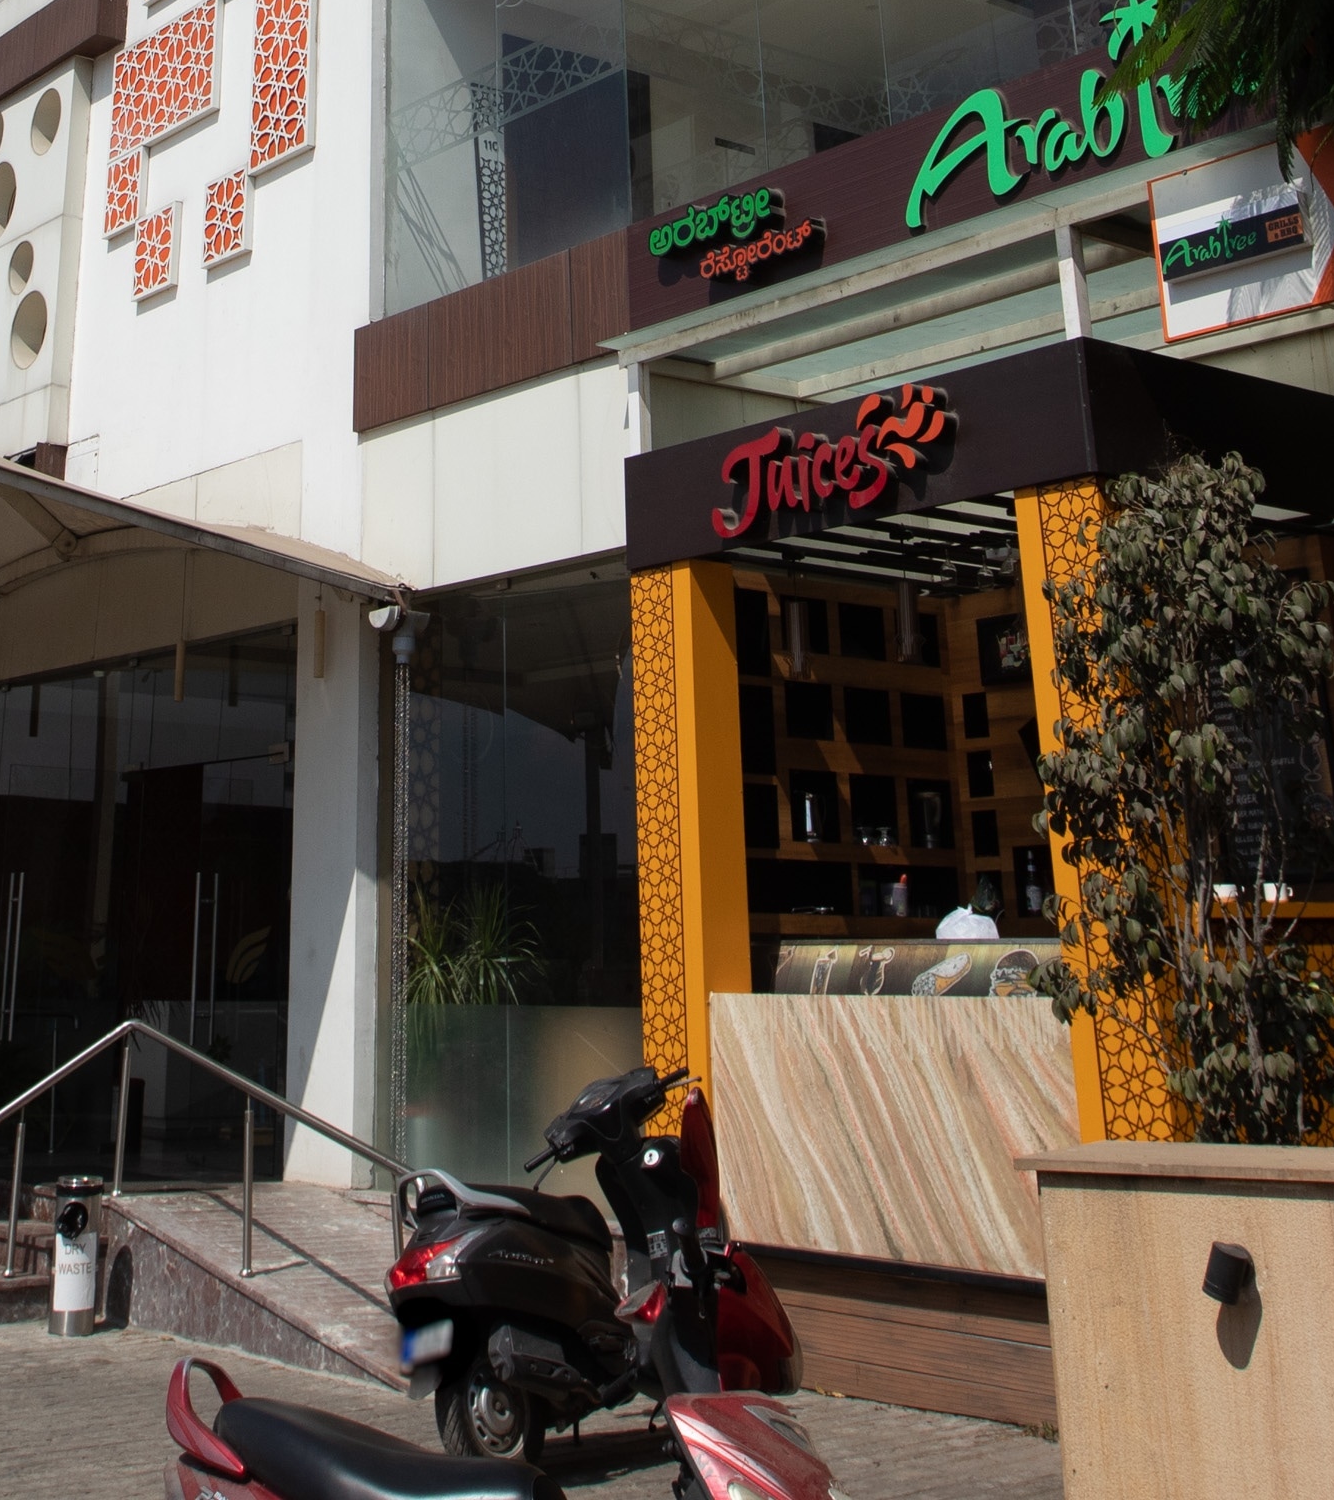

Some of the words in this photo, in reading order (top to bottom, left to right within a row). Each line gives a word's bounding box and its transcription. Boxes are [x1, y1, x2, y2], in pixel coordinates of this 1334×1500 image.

[1267, 215, 1299, 231] GRILLS
[711, 424, 888, 539] Juices
[64, 1243, 87, 1256] DRY
[58, 1262, 92, 1275] WASTE
